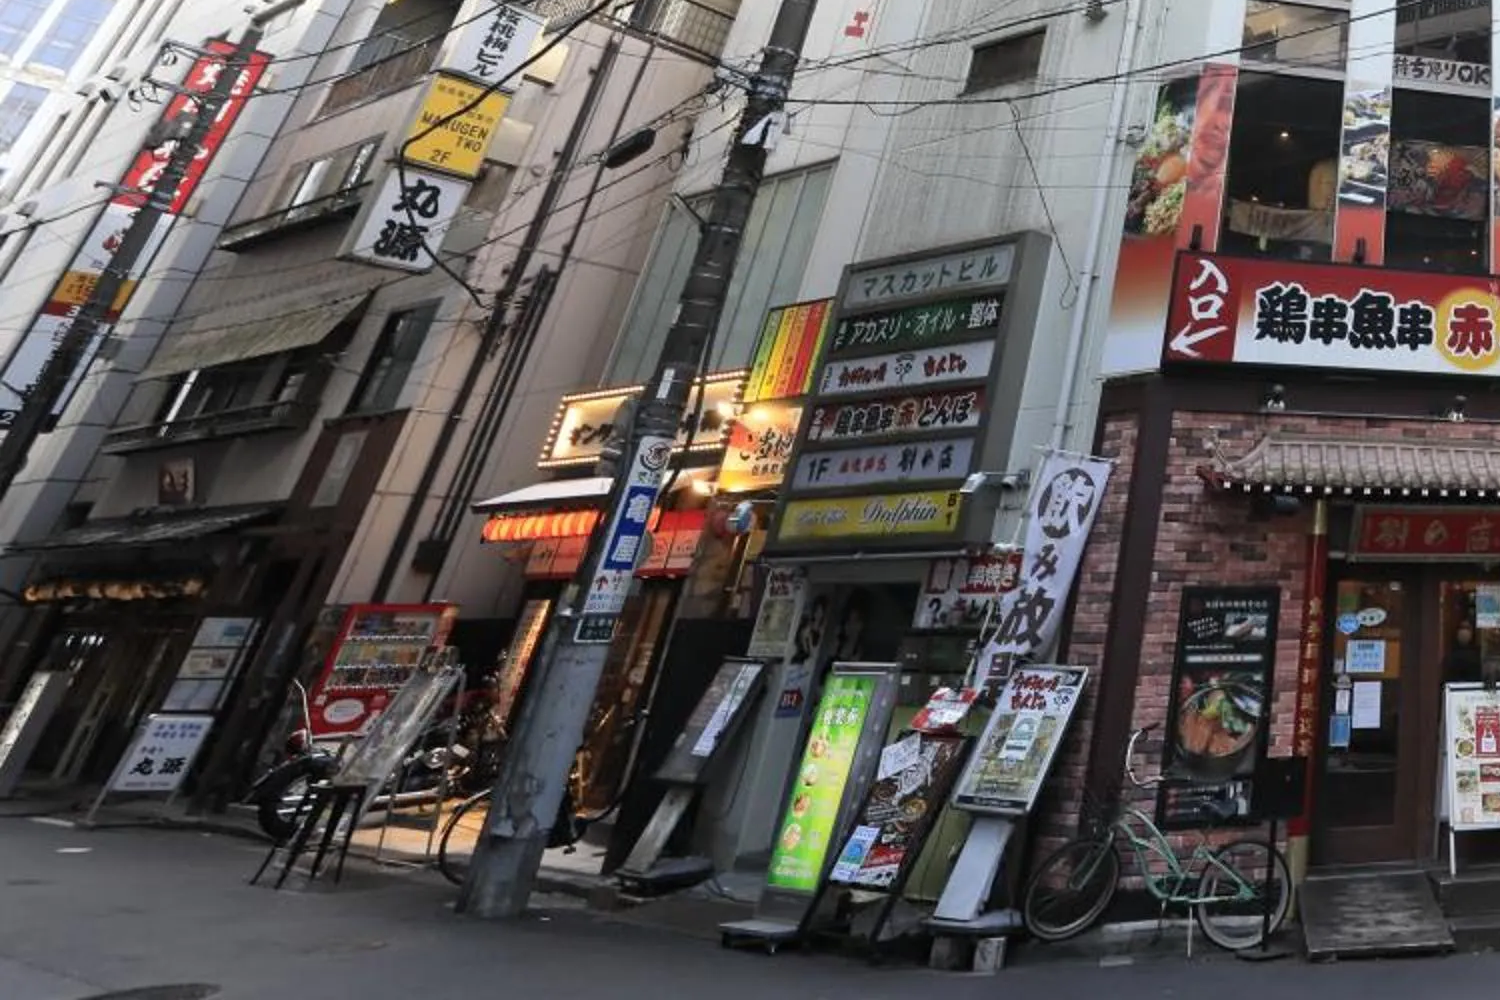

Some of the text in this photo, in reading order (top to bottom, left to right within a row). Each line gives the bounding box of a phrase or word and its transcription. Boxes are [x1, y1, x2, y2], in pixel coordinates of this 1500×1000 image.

[864, 255, 999, 297] マスカットビル
[1186, 259, 1229, 320] 入口
